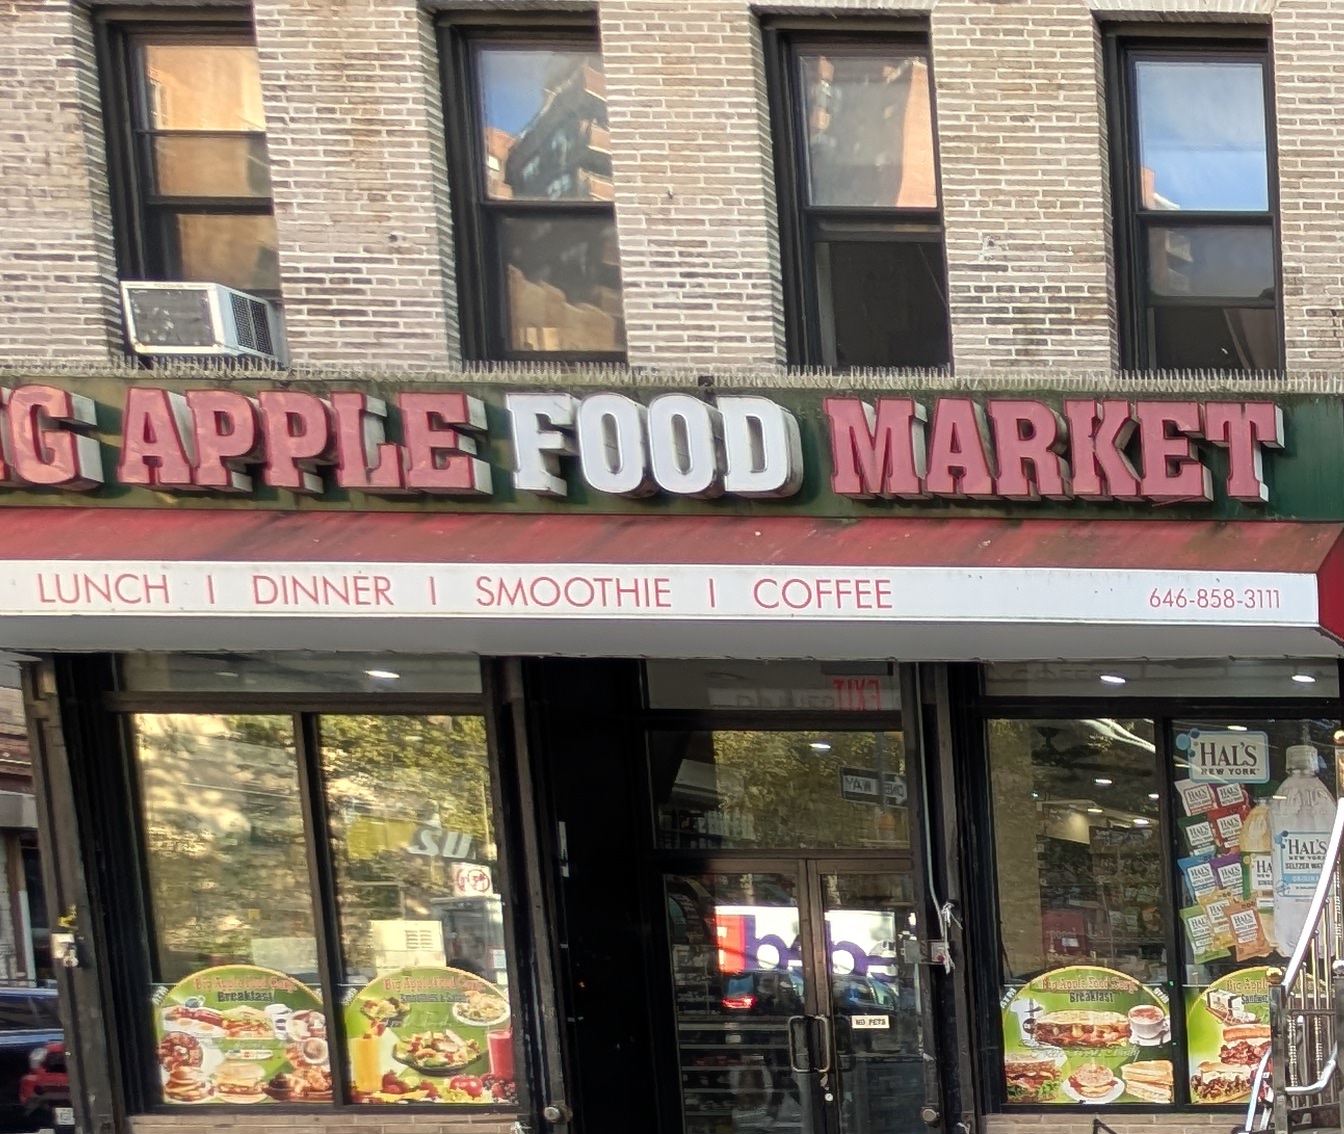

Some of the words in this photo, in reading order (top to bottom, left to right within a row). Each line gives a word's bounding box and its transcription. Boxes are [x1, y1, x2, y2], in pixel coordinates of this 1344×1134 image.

[0, 384, 98, 490] G
[117, 386, 487, 494] APPLE
[506, 392, 800, 497] FOOD
[823, 397, 1282, 501] MARKET
[37, 573, 169, 605] LUNCH
[253, 575, 394, 607] DINNER
[475, 575, 672, 609] SMOOTHIE
[753, 578, 893, 610] COFFEE
[1148, 587, 1281, 610] 646-858-3111
[1200, 741, 1258, 767] HAL'S
[1228, 768, 1257, 776] YORK
[1068, 991, 1115, 1003] Breakfast
